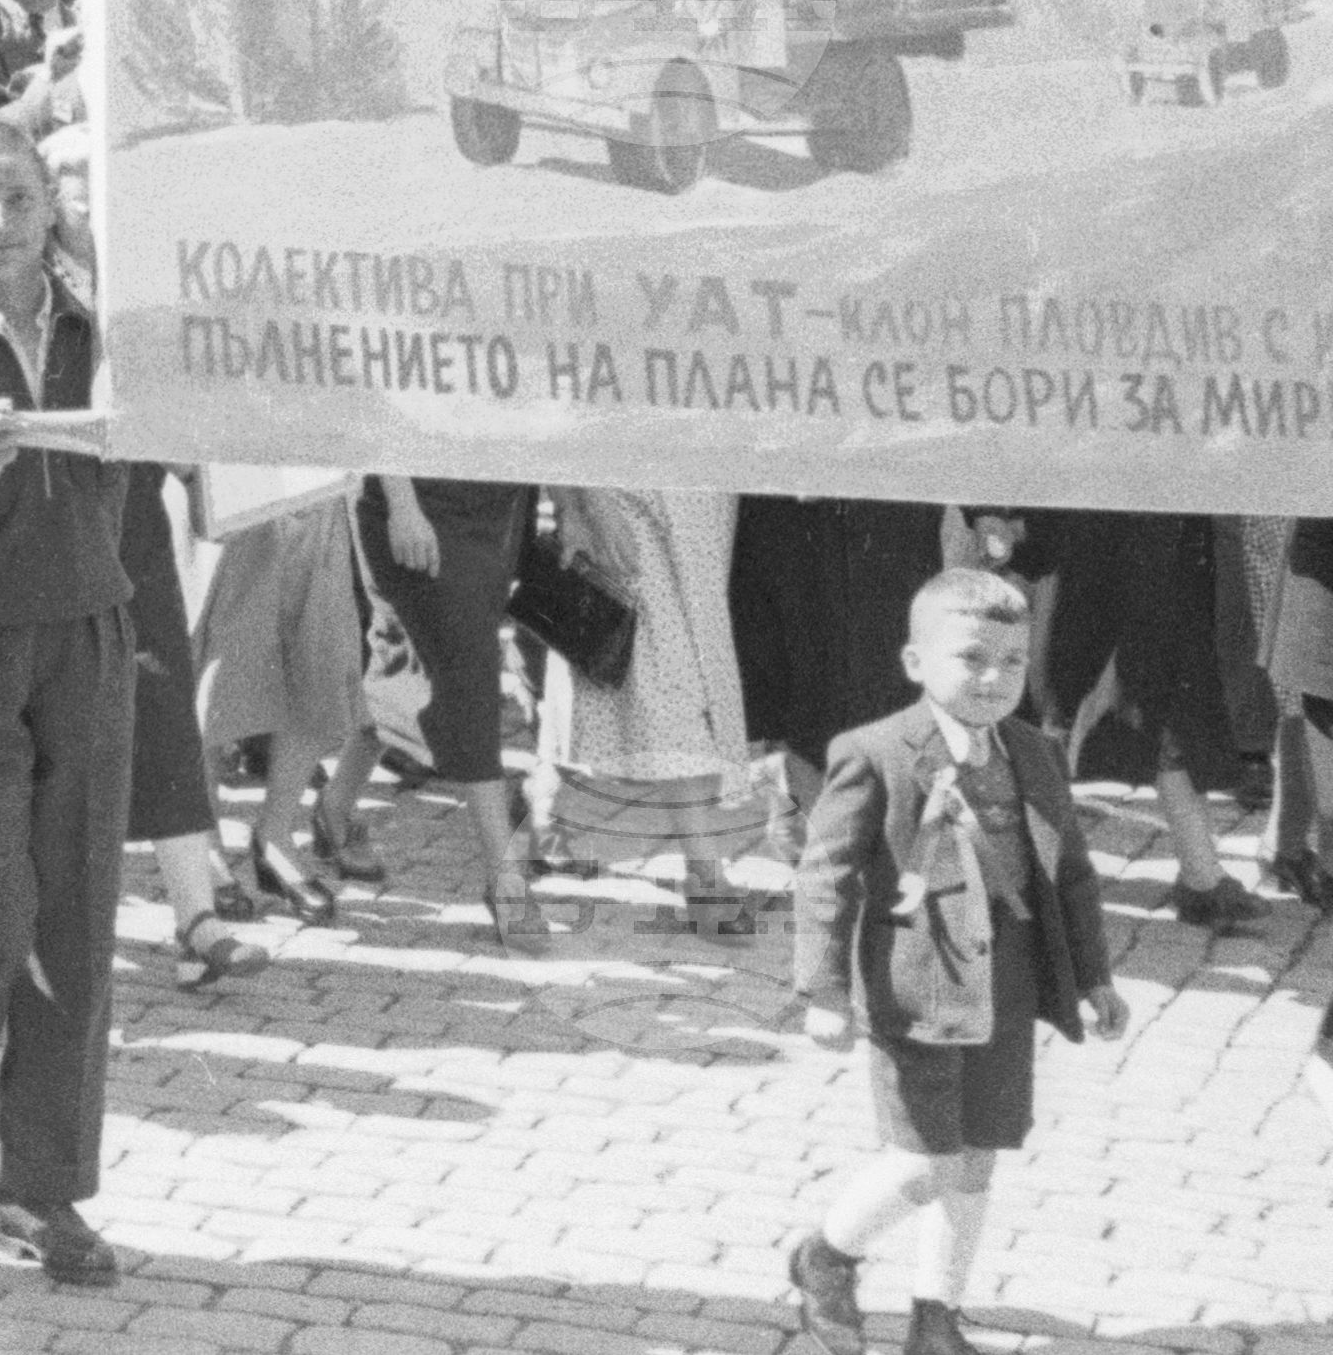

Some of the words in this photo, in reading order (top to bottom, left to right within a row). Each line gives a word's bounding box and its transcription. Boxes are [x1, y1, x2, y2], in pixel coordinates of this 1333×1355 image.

[176, 239, 477, 319] КОЛЕКТИВА
[502, 261, 599, 328] ПРИ
[998, 295, 1242, 369] ПЛОВДИВ
[1261, 307, 1290, 367] С
[181, 314, 520, 401] ПЪЛНЕНИЕТО
[547, 341, 624, 404] НА
[643, 347, 841, 416] ПЛАНА
[862, 360, 922, 423] СЕ
[945, 363, 1100, 430] БОРИ
[1119, 372, 1185, 434] ЗА
[1200, 372, 1333, 440] МИР
